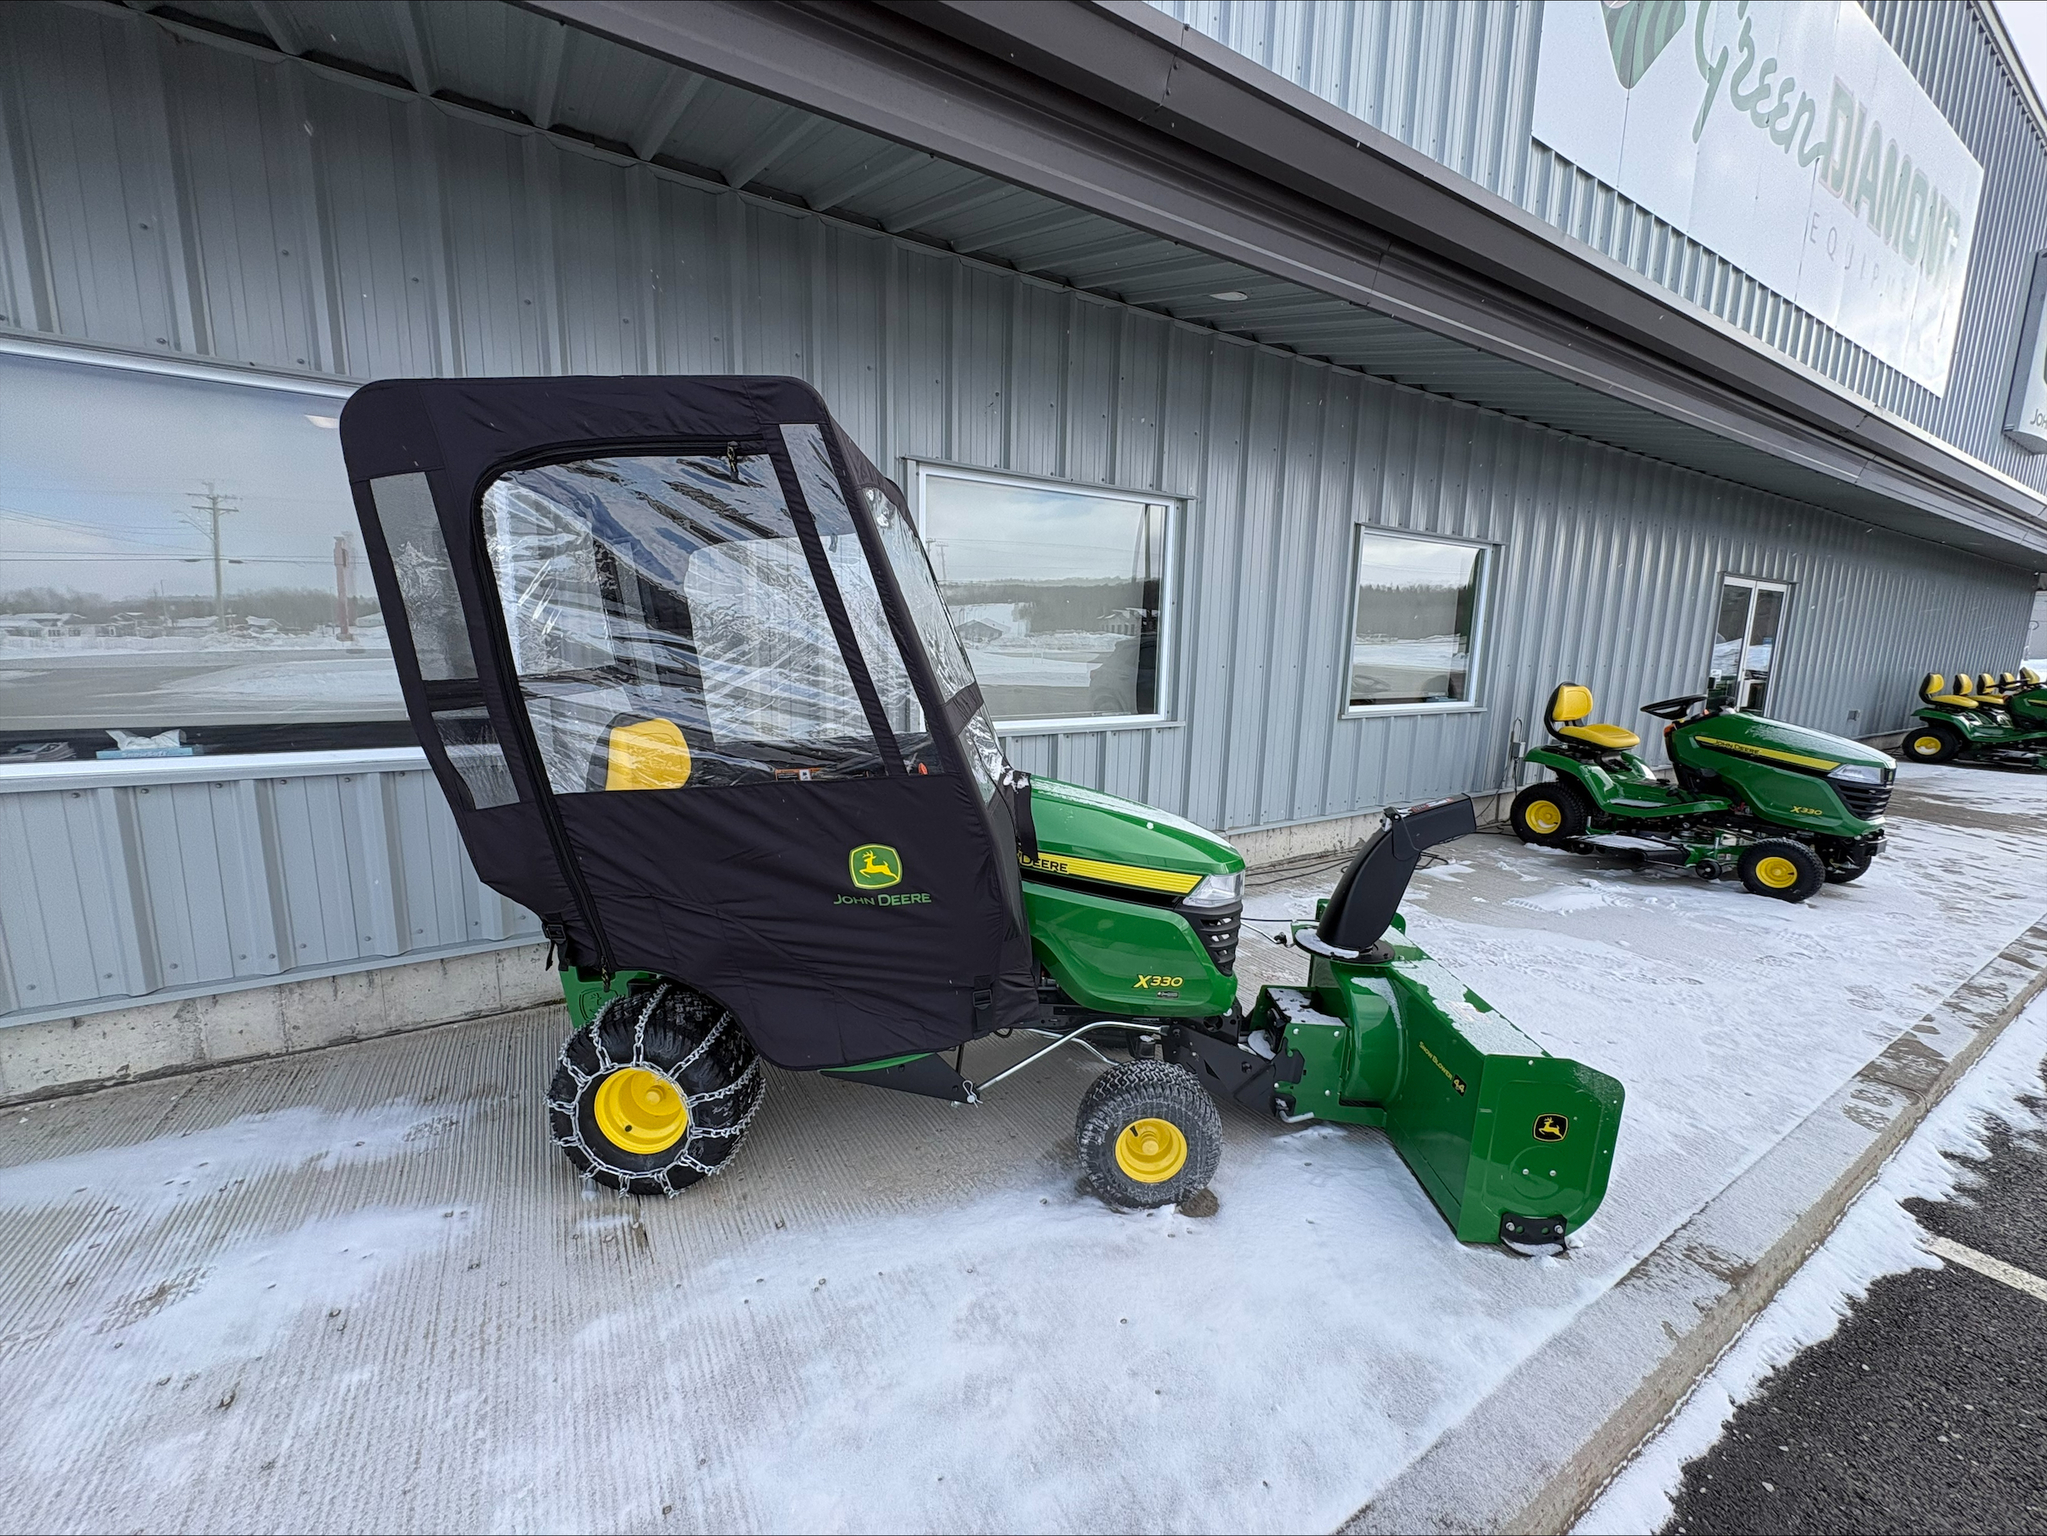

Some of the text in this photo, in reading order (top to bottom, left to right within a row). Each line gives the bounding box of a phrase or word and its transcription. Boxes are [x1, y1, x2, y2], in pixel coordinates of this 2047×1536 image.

[1715, 740, 1760, 754] JOHN DEERE
[1790, 805, 1823, 815] X330
[833, 893, 932, 907] JOHN DEERE
[1132, 974, 1184, 989] X330
[1453, 1079, 1465, 1093] 44
